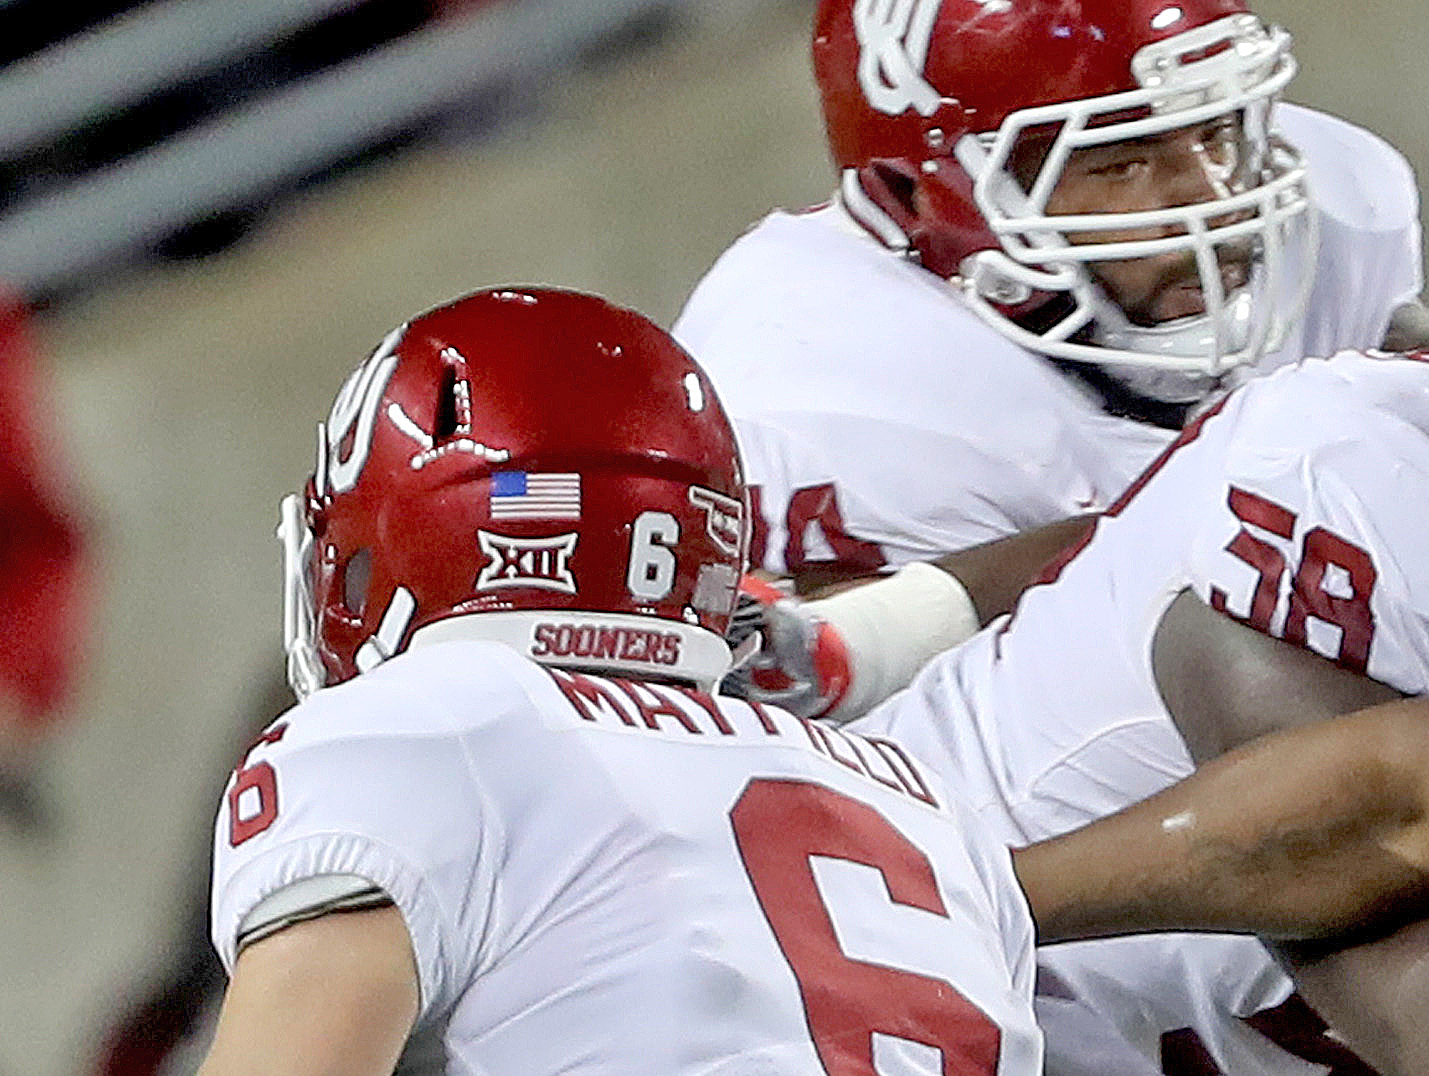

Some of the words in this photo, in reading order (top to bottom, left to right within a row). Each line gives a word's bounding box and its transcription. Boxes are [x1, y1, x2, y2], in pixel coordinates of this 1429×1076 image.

[626, 510, 681, 600] 6
[1204, 483, 1377, 676] 58
[530, 622, 682, 665] SOONERS
